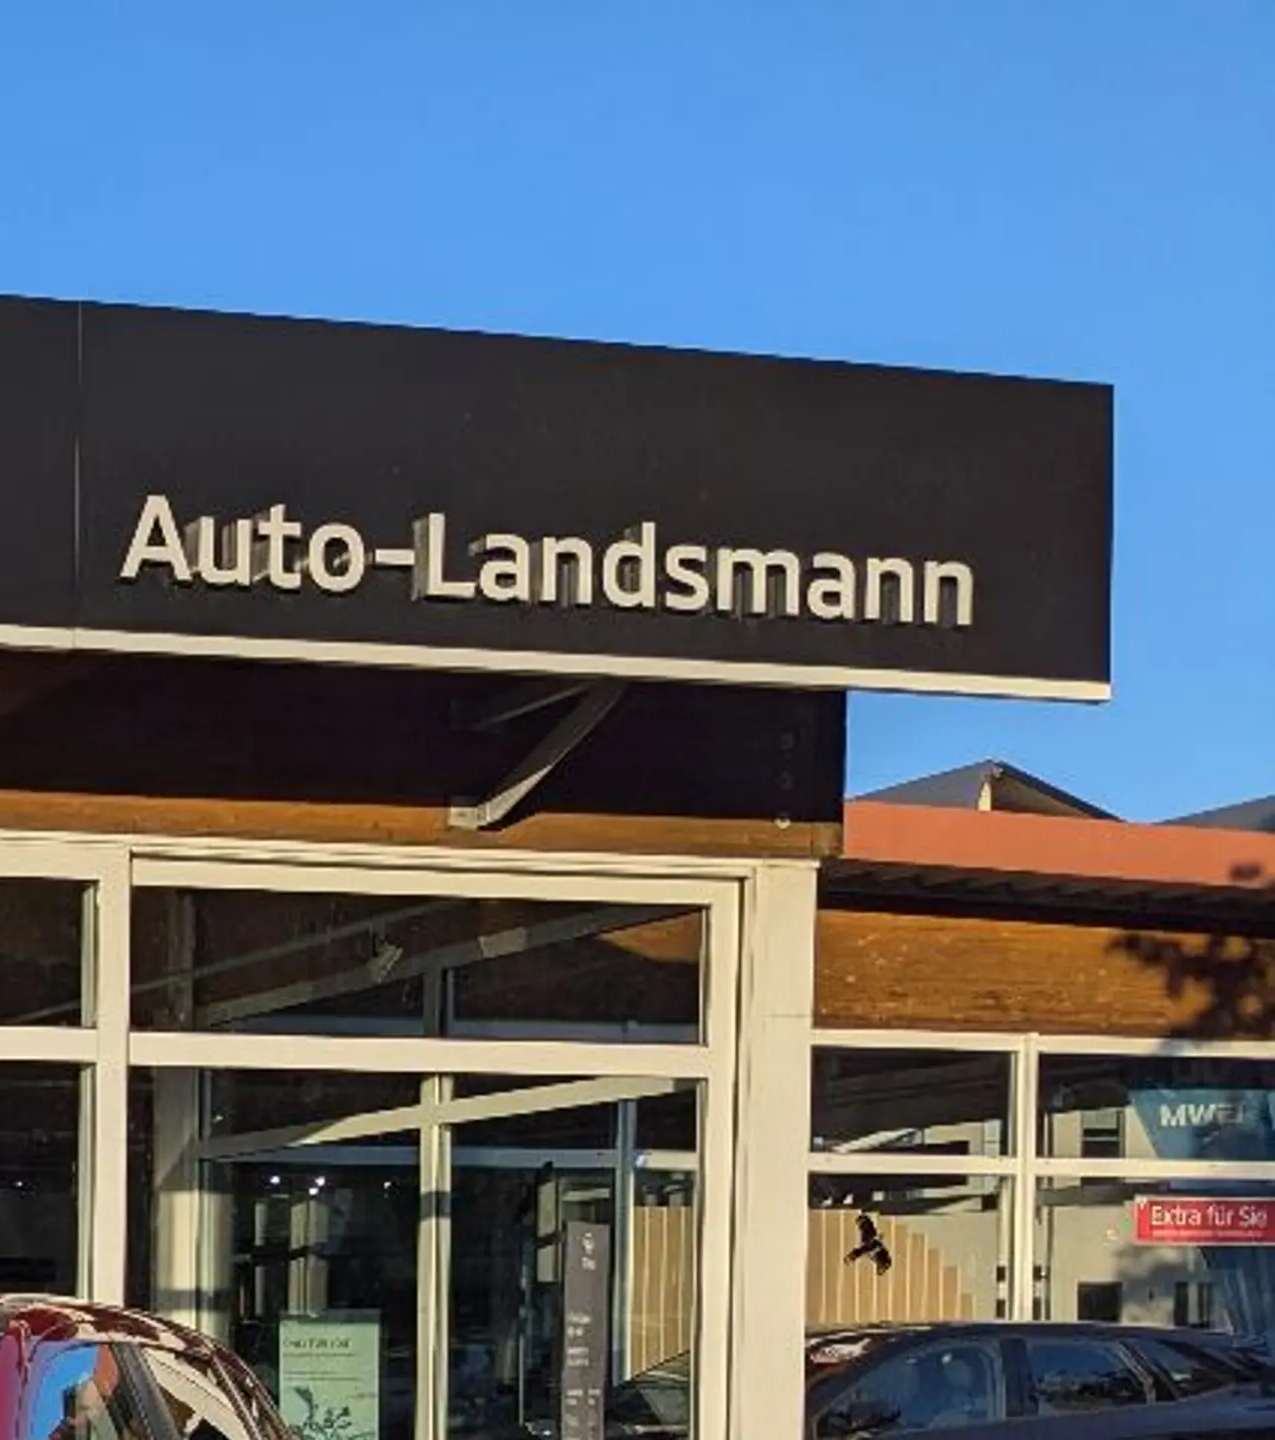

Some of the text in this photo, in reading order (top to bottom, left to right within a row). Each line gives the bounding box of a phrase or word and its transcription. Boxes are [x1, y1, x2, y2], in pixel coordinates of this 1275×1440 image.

[119, 494, 974, 626] Auto-Landsmann
[1151, 1204, 1202, 1226] Extra
[1207, 1202, 1233, 1226] für
